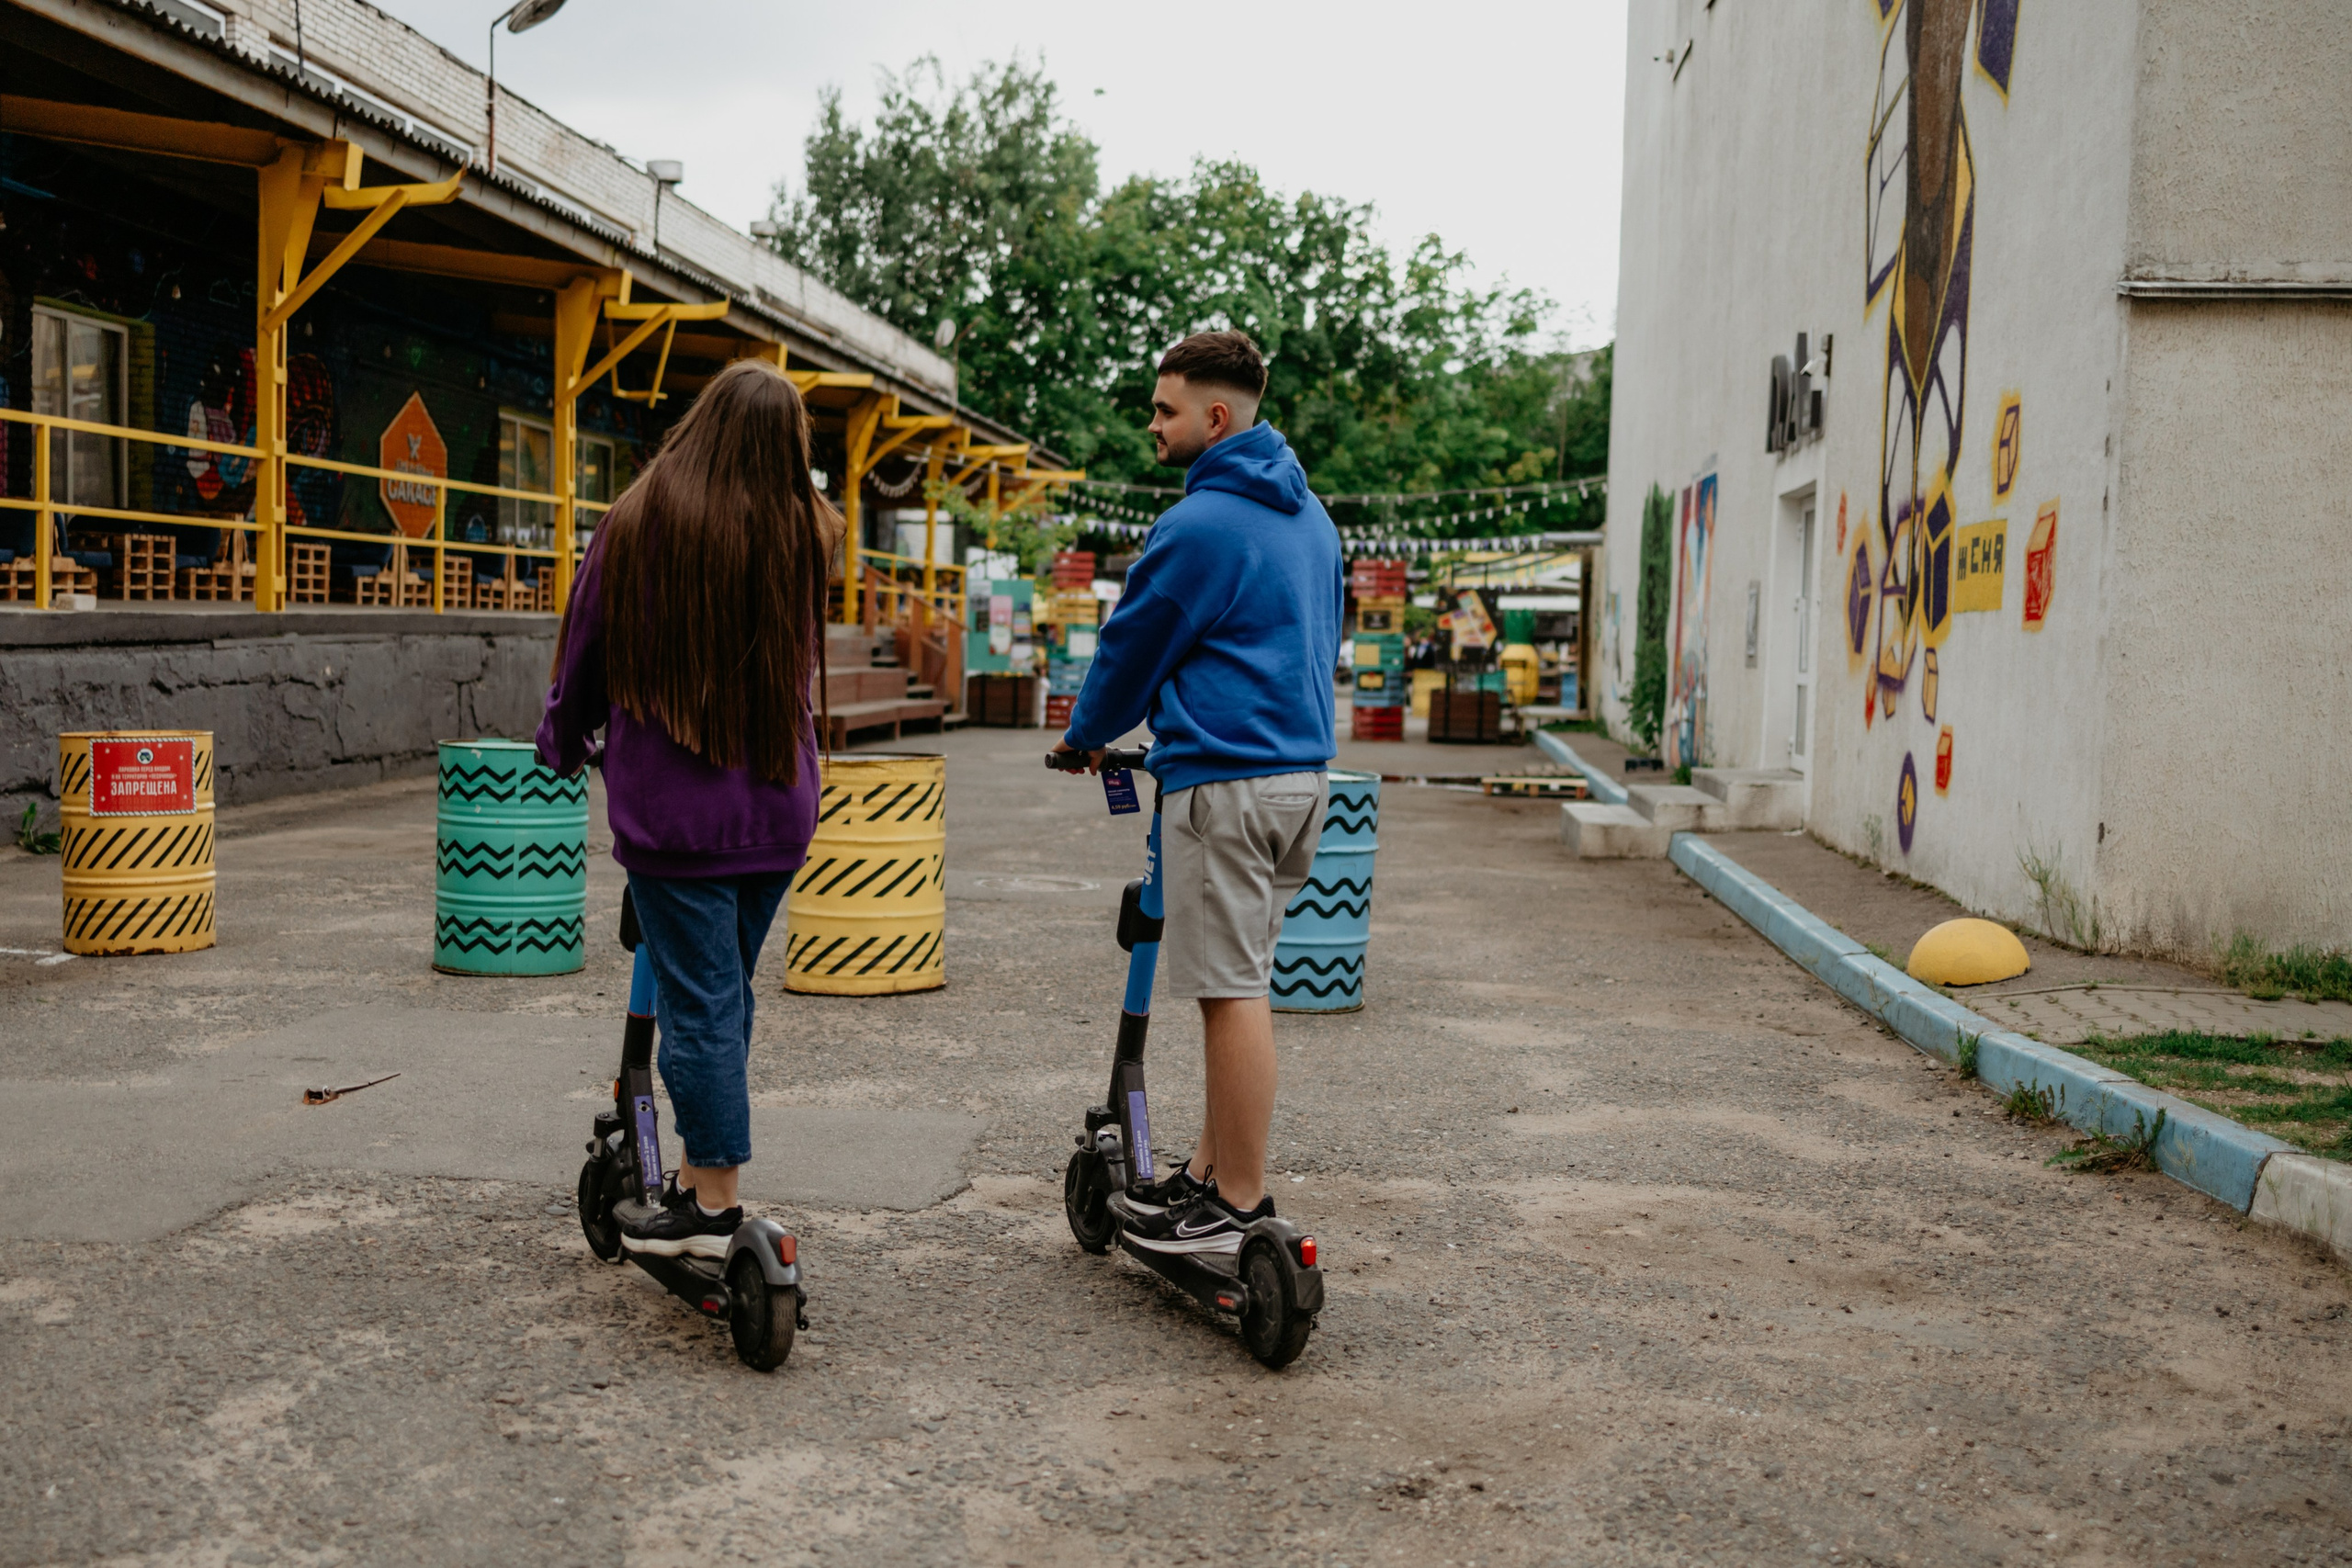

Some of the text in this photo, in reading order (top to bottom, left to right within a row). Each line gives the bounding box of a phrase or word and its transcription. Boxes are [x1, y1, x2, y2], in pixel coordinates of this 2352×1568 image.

[1957, 534, 2004, 581] ЖЕНЯ
[111, 780, 177, 796] ЗАПРЕЩЕНА
[1143, 845, 1157, 886] JET
